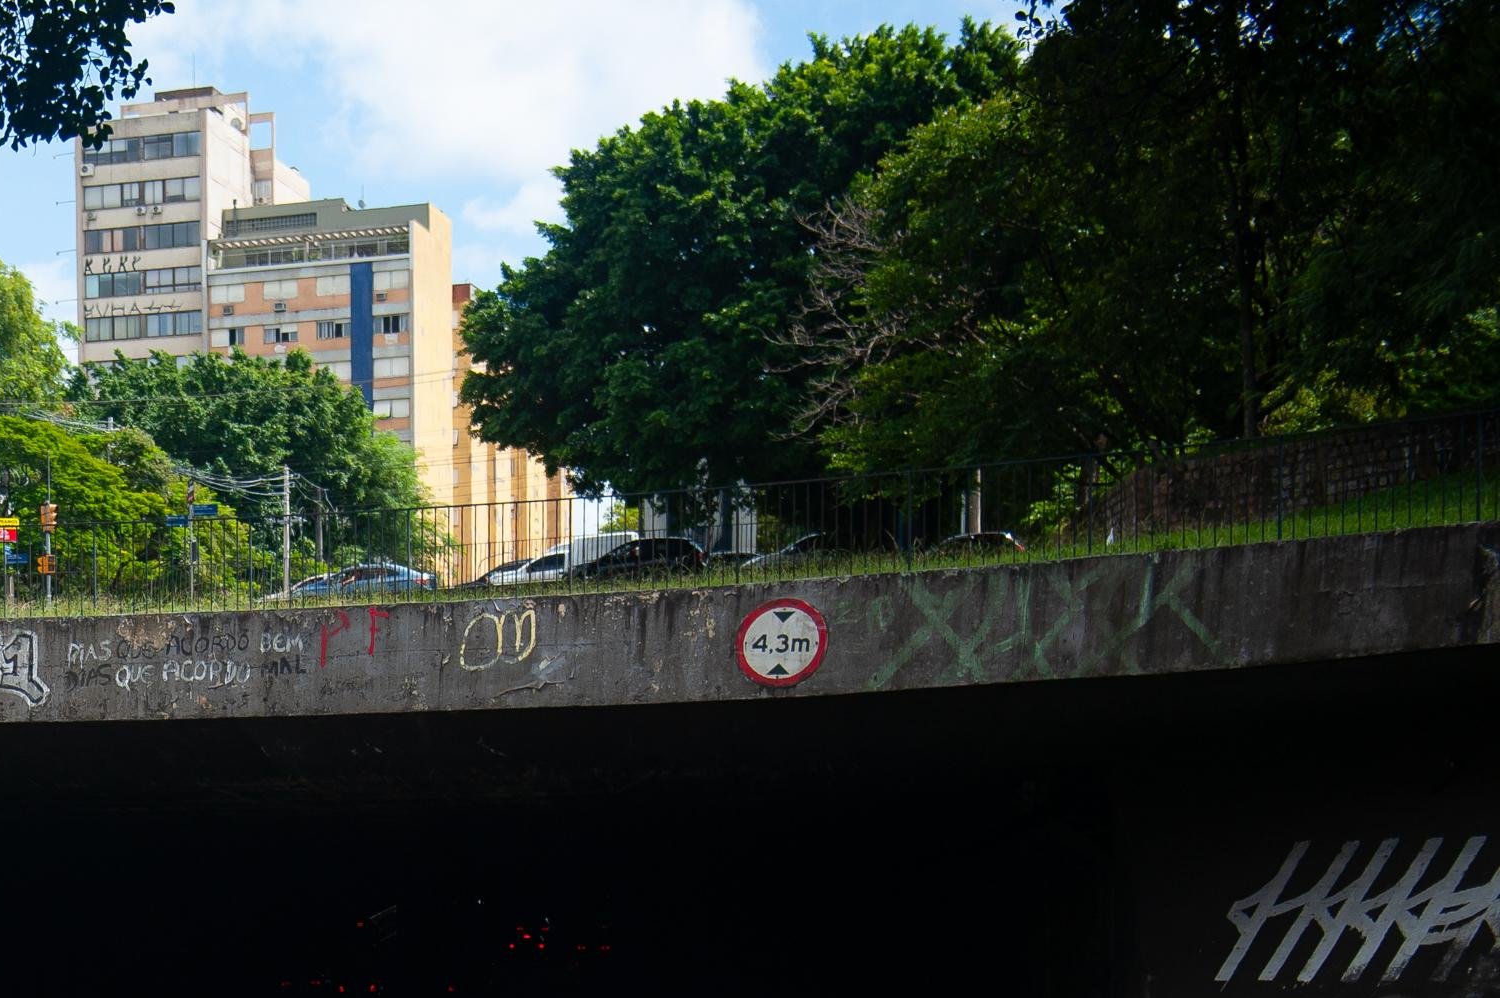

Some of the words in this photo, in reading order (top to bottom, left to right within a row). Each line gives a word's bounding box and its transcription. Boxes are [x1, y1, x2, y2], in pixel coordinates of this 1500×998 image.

[260, 632, 304, 654] BEM
[752, 633, 810, 654] 4,3m
[115, 664, 156, 692] QUE
[162, 659, 251, 685] ACORDO
